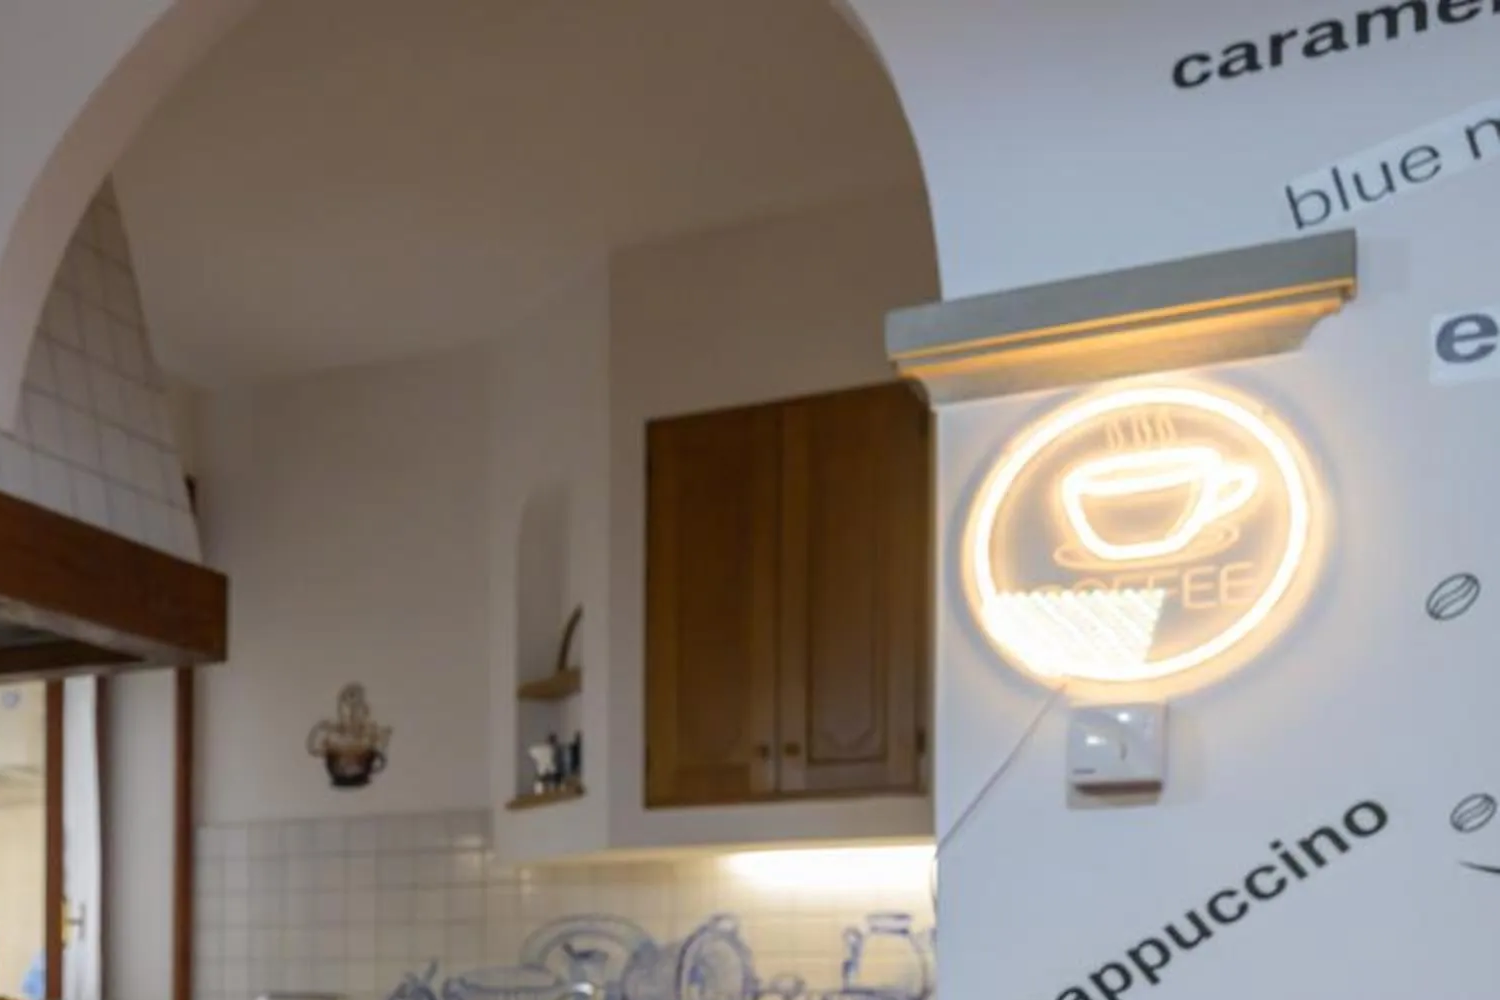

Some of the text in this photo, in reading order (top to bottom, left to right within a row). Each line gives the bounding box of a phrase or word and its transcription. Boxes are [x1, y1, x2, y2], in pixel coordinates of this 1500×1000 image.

[1284, 144, 1442, 230] blue
[1435, 312, 1499, 364] e
[1032, 561, 1257, 609] FEE
